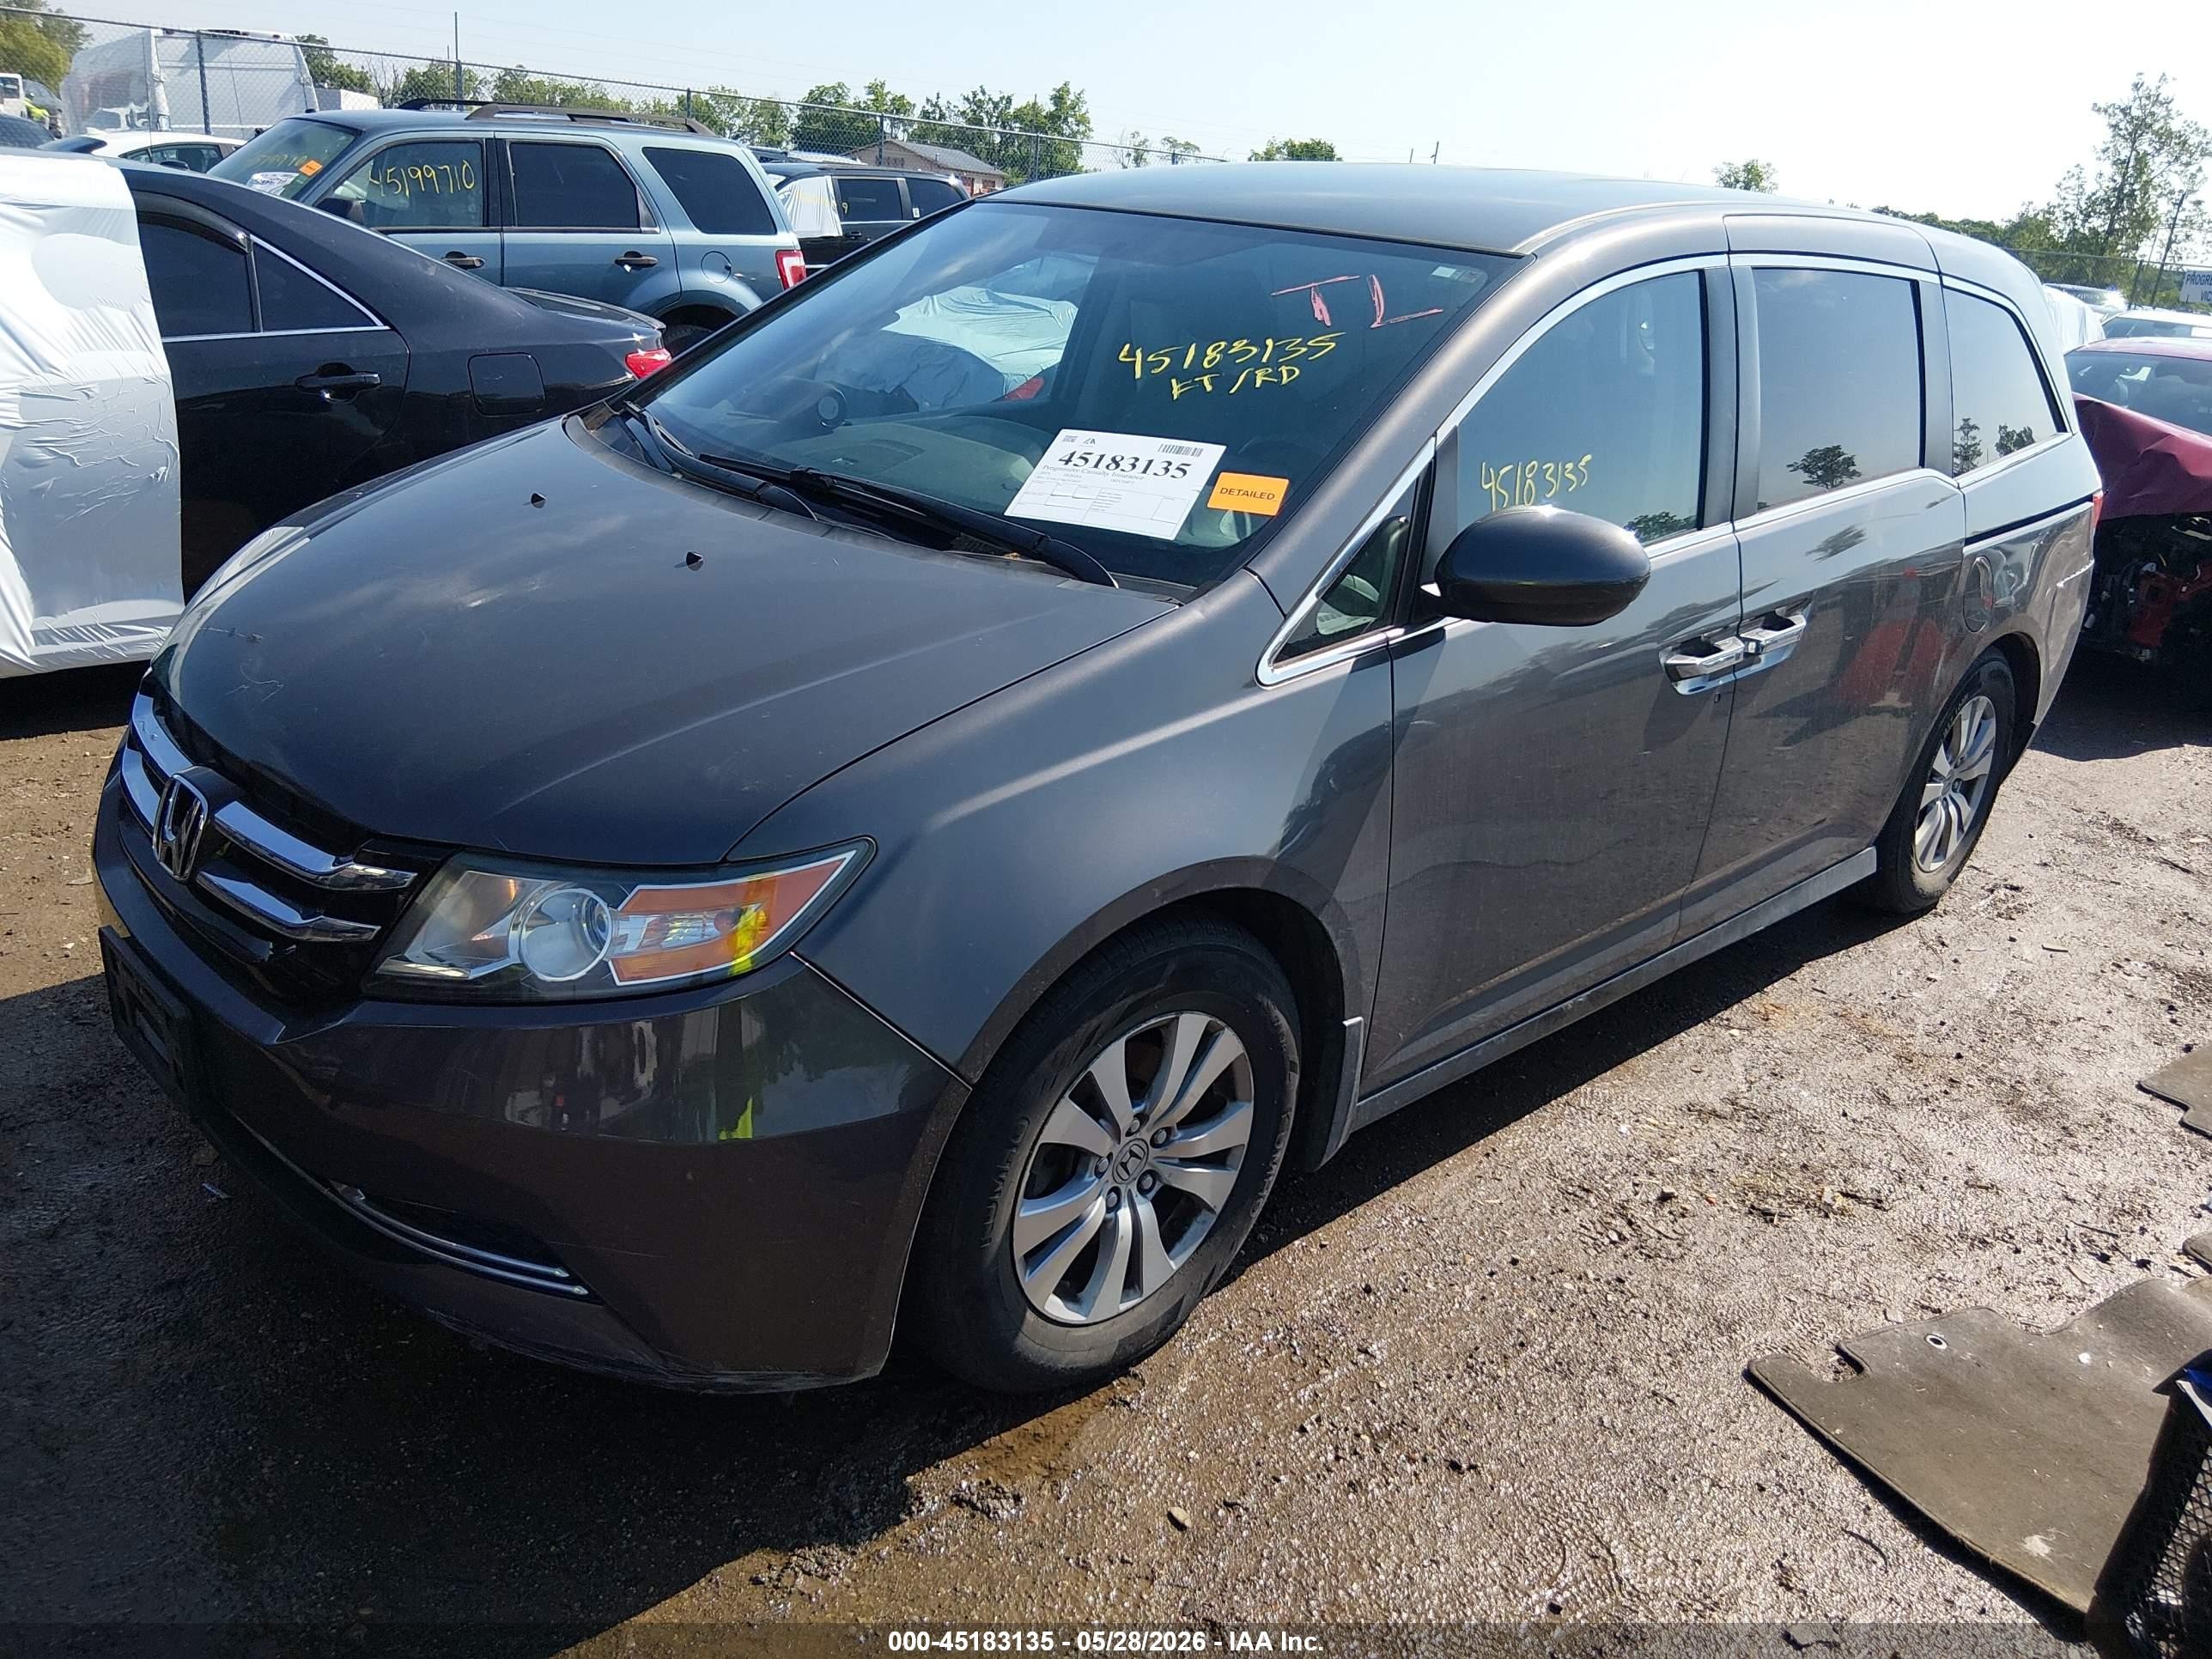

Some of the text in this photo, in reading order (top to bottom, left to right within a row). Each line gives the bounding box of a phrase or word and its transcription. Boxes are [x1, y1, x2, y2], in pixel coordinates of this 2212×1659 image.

[368, 159, 475, 198] 45199710
[1119, 332, 1347, 380] 45183135
[1058, 450, 1193, 480] 45183135
[1481, 454, 1592, 512] 45183135
[1220, 487, 1275, 501] DETAILED
